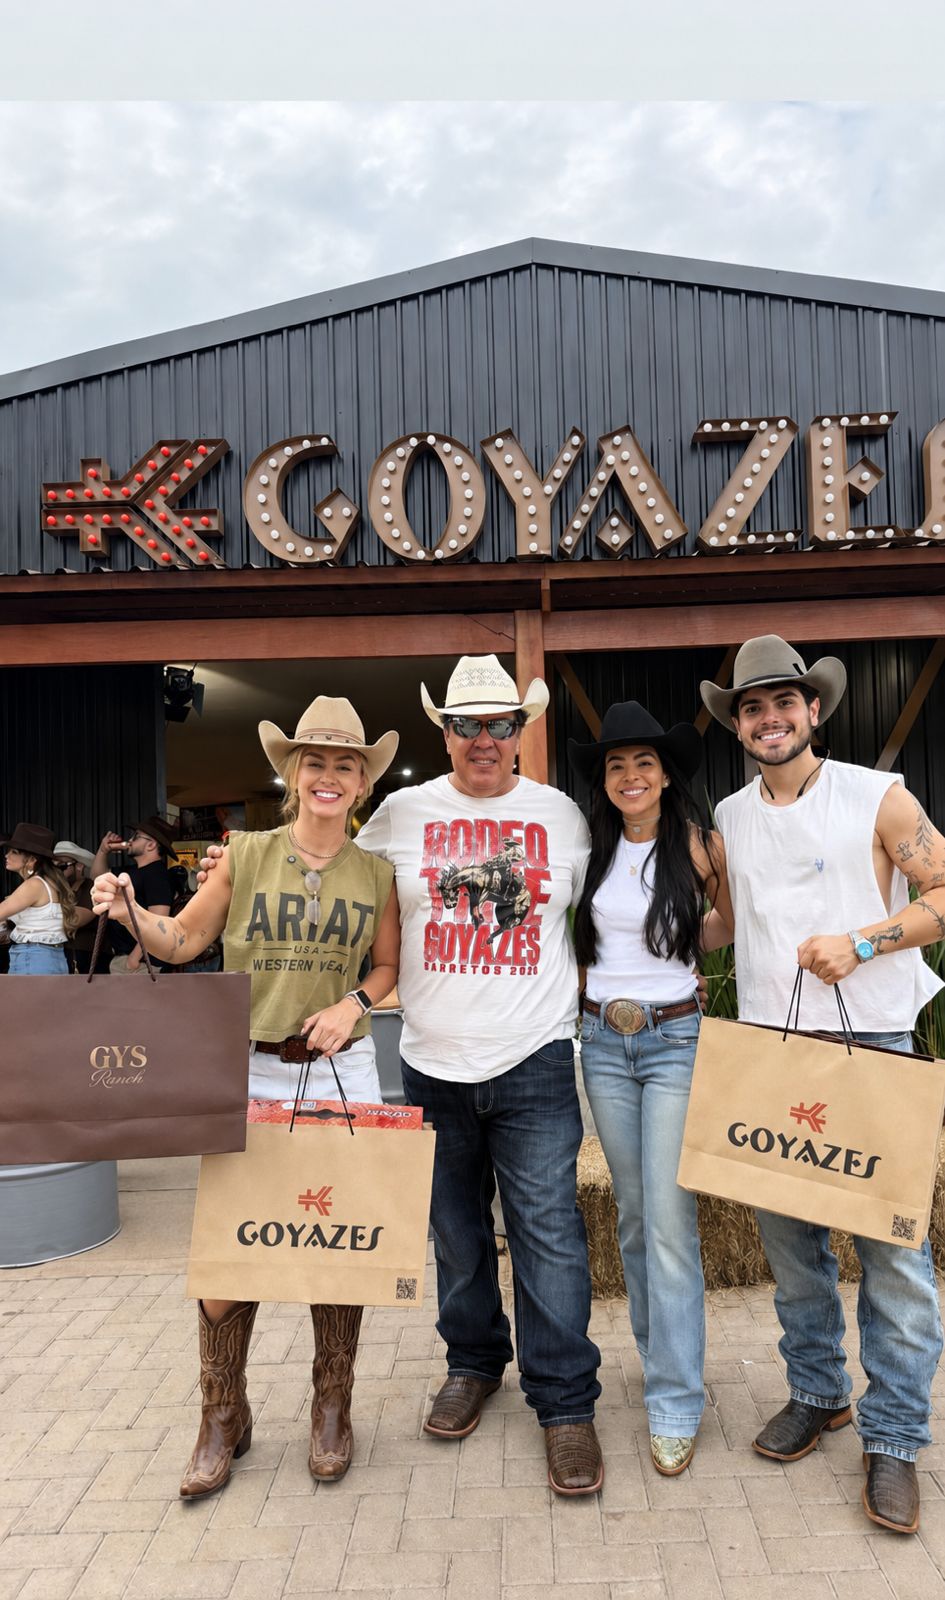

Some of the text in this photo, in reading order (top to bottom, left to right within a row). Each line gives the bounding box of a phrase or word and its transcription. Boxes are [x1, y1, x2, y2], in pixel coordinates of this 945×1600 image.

[422, 818, 550, 868] RODEO
[419, 867, 552, 926] TIE
[293, 945, 320, 954] USA
[424, 921, 541, 966] GOYAZES
[253, 959, 313, 972] WESTERN
[424, 962, 501, 975] BARRETOS
[90, 1045, 147, 1069] GYS
[89, 1069, 146, 1088] Ranch
[727, 1122, 882, 1179] GOYAZES
[237, 1220, 384, 1251] GOYAZES
